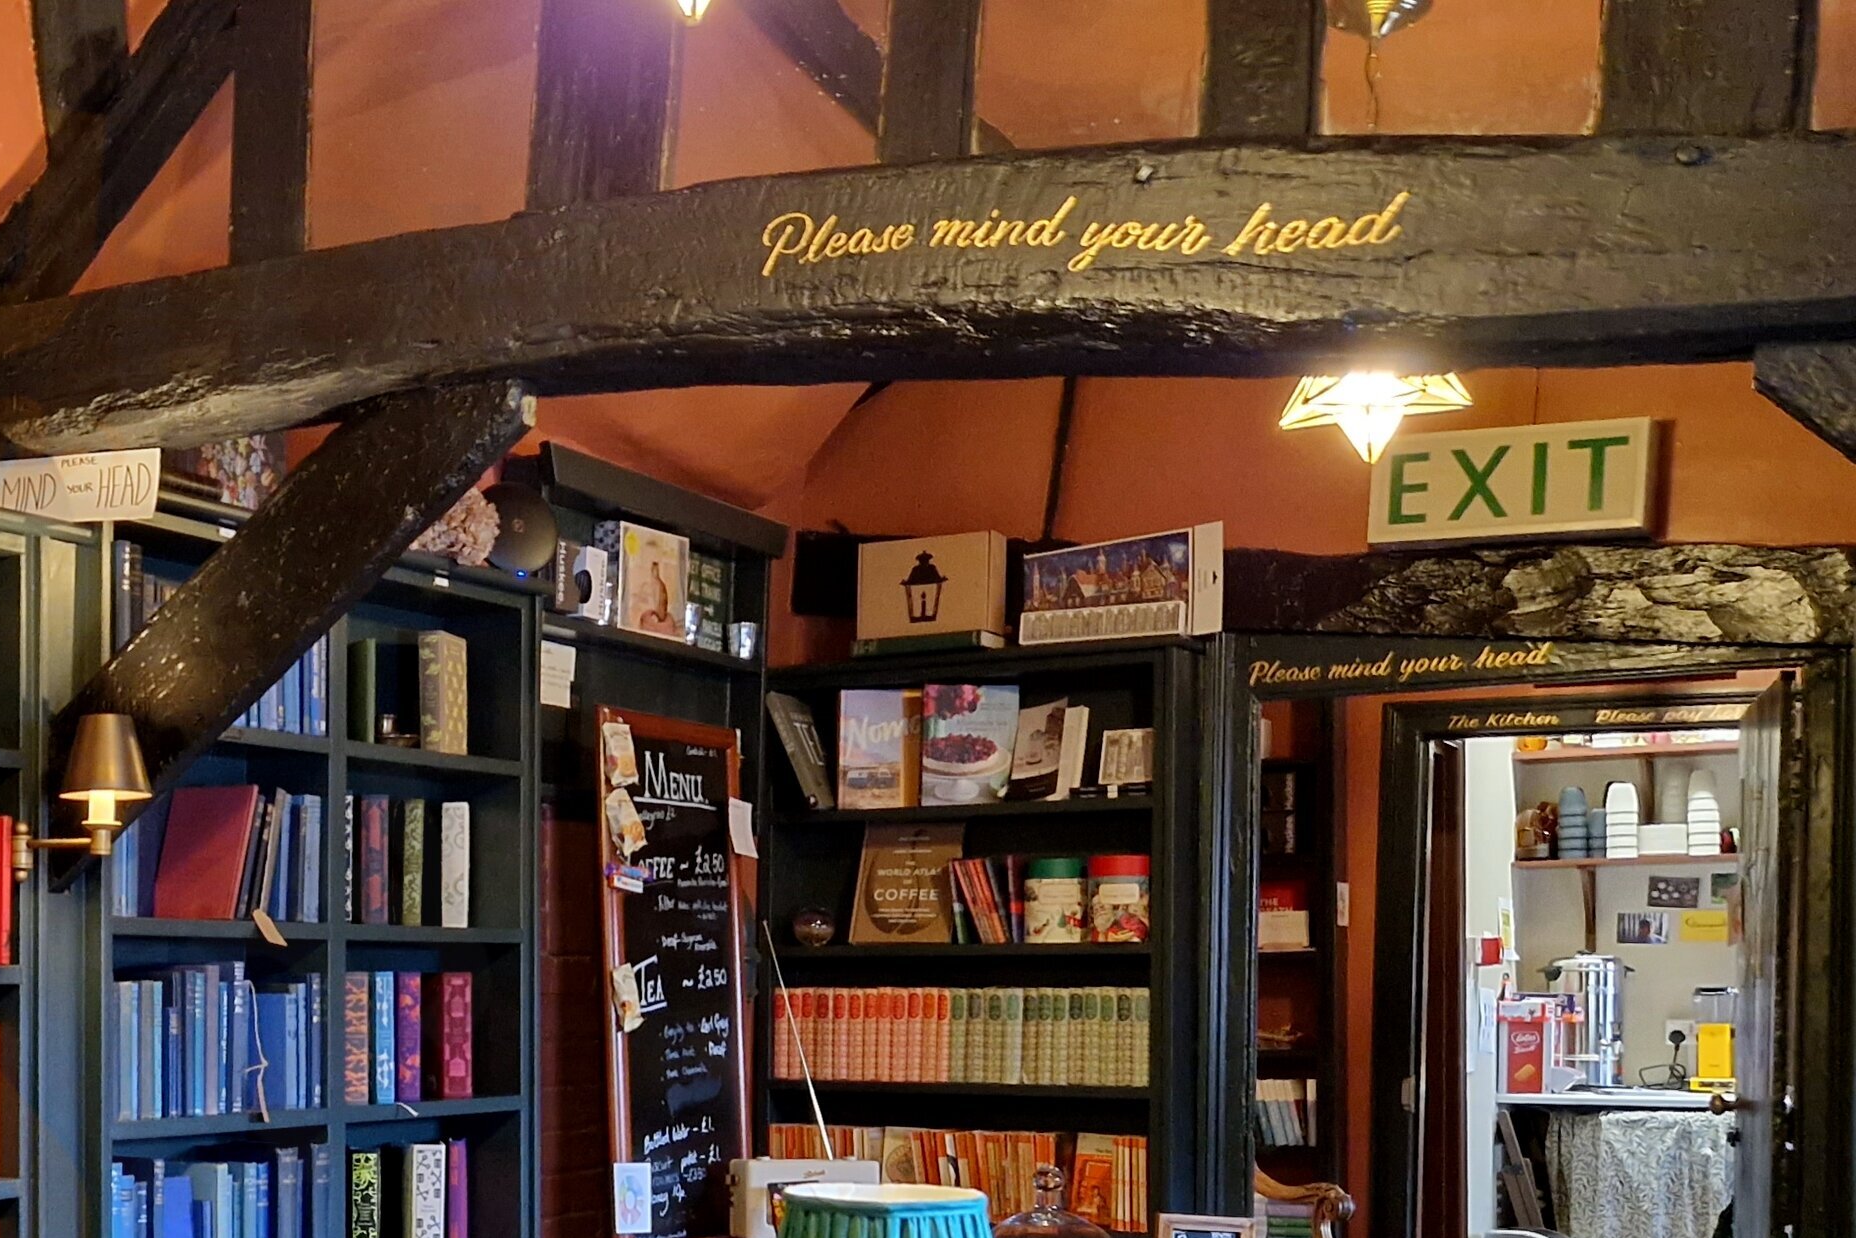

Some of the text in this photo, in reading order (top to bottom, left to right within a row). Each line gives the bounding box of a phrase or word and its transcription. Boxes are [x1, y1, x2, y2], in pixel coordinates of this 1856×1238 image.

[762, 190, 1412, 276] Please mind your head
[61, 456, 98, 467] PLEASE
[2, 463, 152, 512] MIND YOUR HEAD
[1387, 436, 1630, 526] EXIT
[558, 541, 567, 604] Huskee
[1249, 641, 1553, 687] Please mind your head
[1448, 709, 1560, 729] The Kitchen
[1595, 708, 1656, 725] Please
[1662, 708, 1703, 726] pay
[877, 868, 912, 877] WORLD
[874, 888, 941, 901] COFFEE
